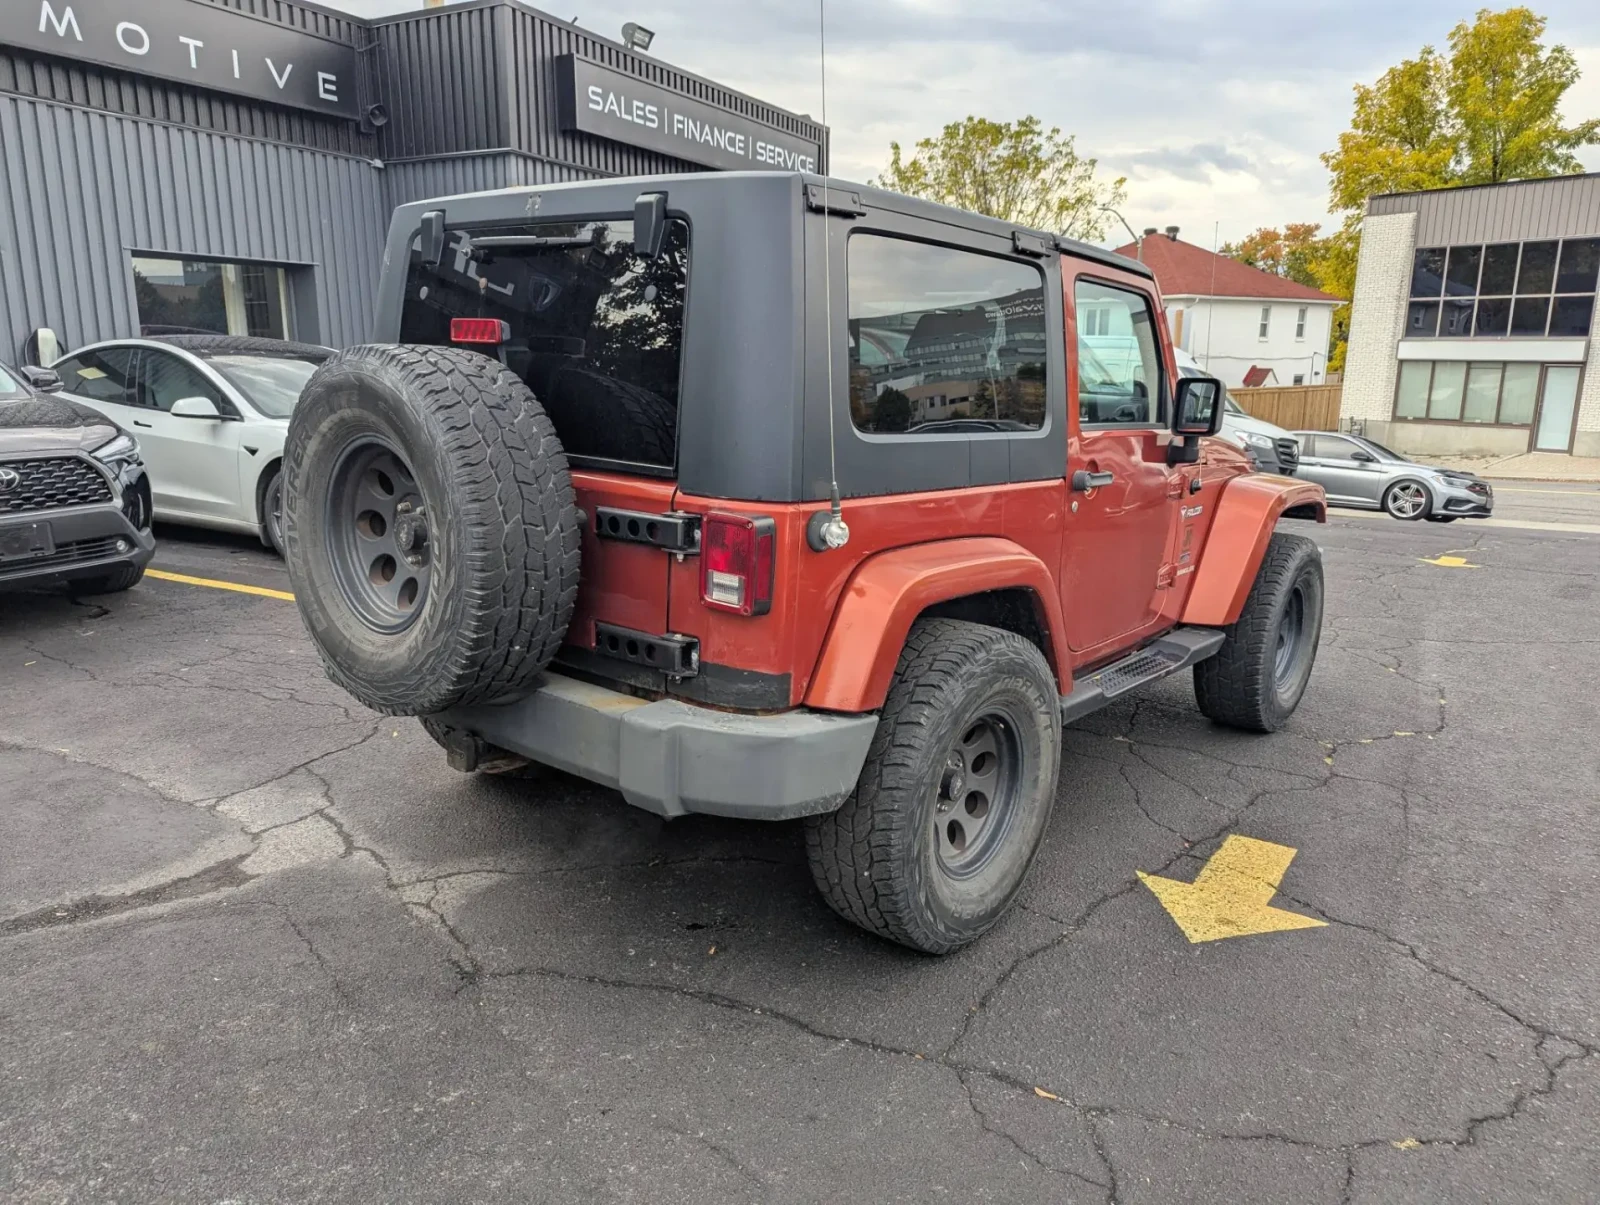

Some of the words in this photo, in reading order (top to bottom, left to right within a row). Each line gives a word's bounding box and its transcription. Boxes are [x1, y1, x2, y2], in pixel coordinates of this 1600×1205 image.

[38, 0, 338, 102] MOTIVE
[588, 85, 658, 128] SALES
[673, 113, 745, 155] FINANCE
[756, 141, 814, 174] SERVICE
[286, 424, 328, 632] DOVERER
